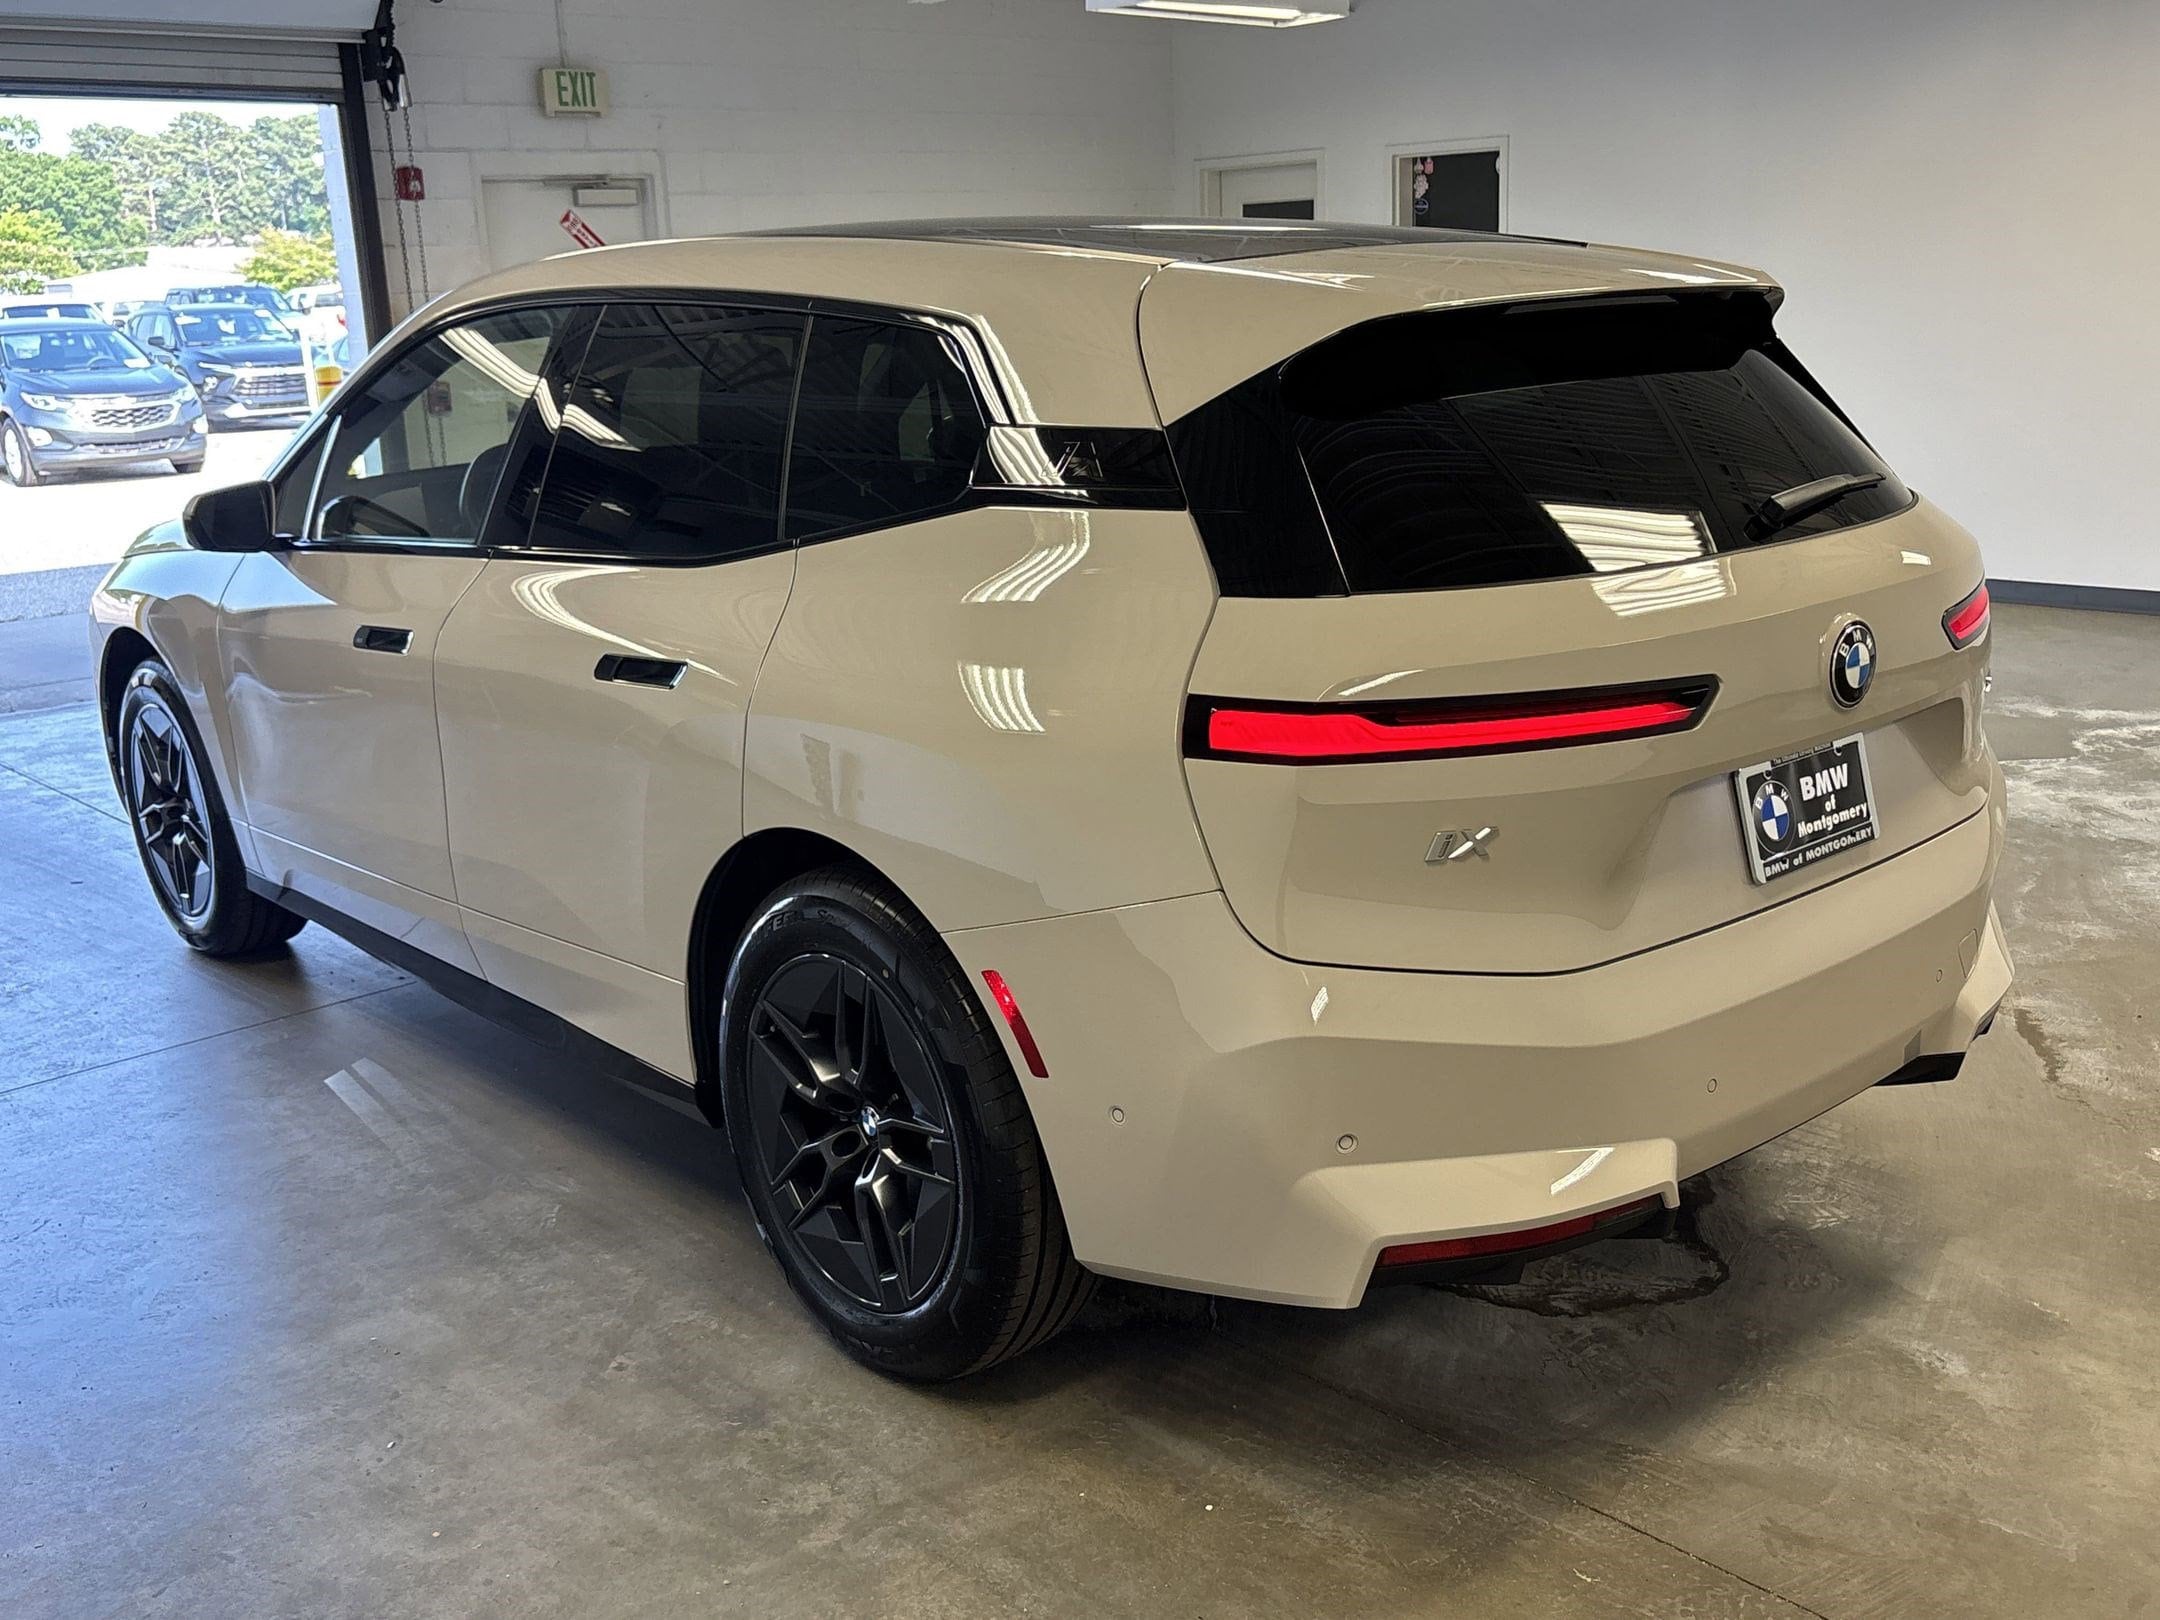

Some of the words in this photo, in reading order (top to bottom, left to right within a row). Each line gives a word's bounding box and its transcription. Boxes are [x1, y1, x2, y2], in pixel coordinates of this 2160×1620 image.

[556, 71, 596, 107] EXIT
[1838, 629, 1873, 657] BMW
[1754, 783, 1789, 810] BMW
[1800, 763, 1848, 801] BMW
[1797, 802, 1868, 838] Montgomery
[1825, 794, 1836, 811] of
[1765, 858, 1790, 877] BMW
[1793, 853, 1803, 866] of
[1806, 826, 1872, 861] MONTGOMERY
